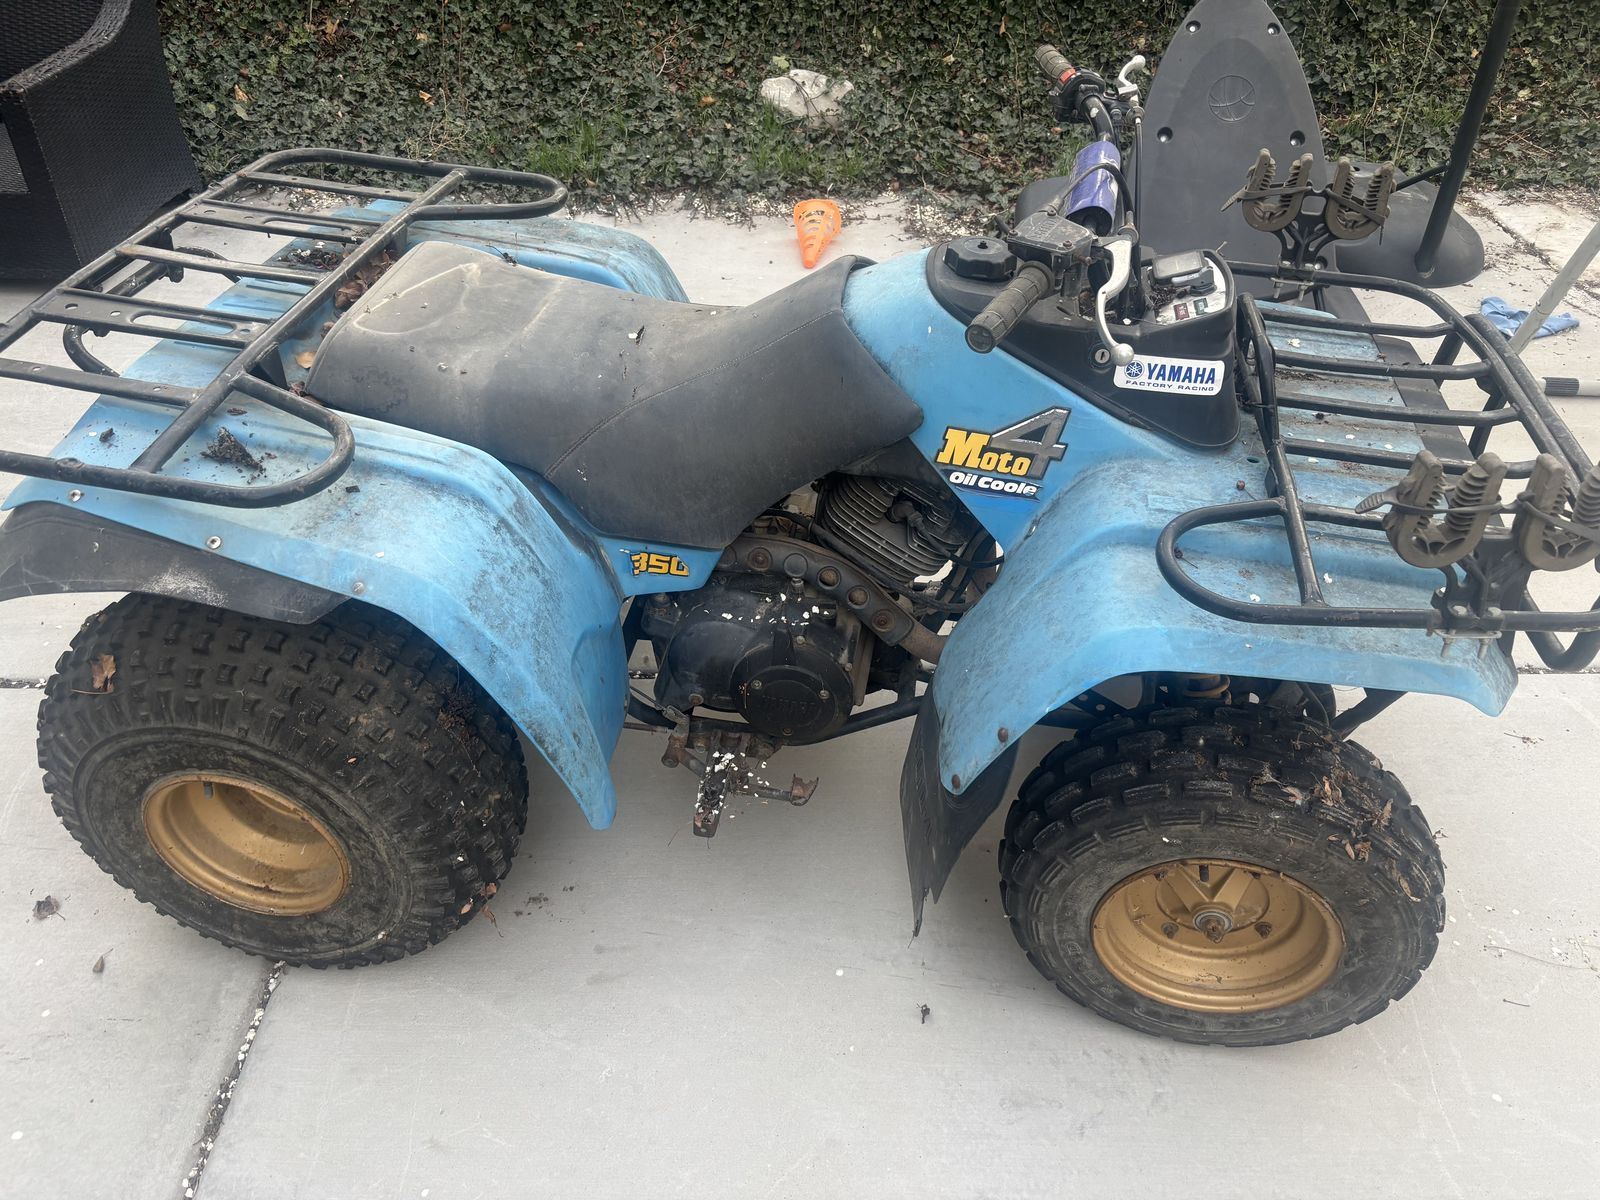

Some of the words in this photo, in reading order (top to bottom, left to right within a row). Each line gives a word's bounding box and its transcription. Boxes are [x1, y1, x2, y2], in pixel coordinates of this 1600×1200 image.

[1147, 363, 1216, 384] YAMAHA
[1125, 380, 1173, 389] FACTORY
[936, 427, 1032, 476] Moto
[990, 405, 1071, 480] 4
[949, 471, 978, 486] Oil
[630, 552, 689, 577] 350
